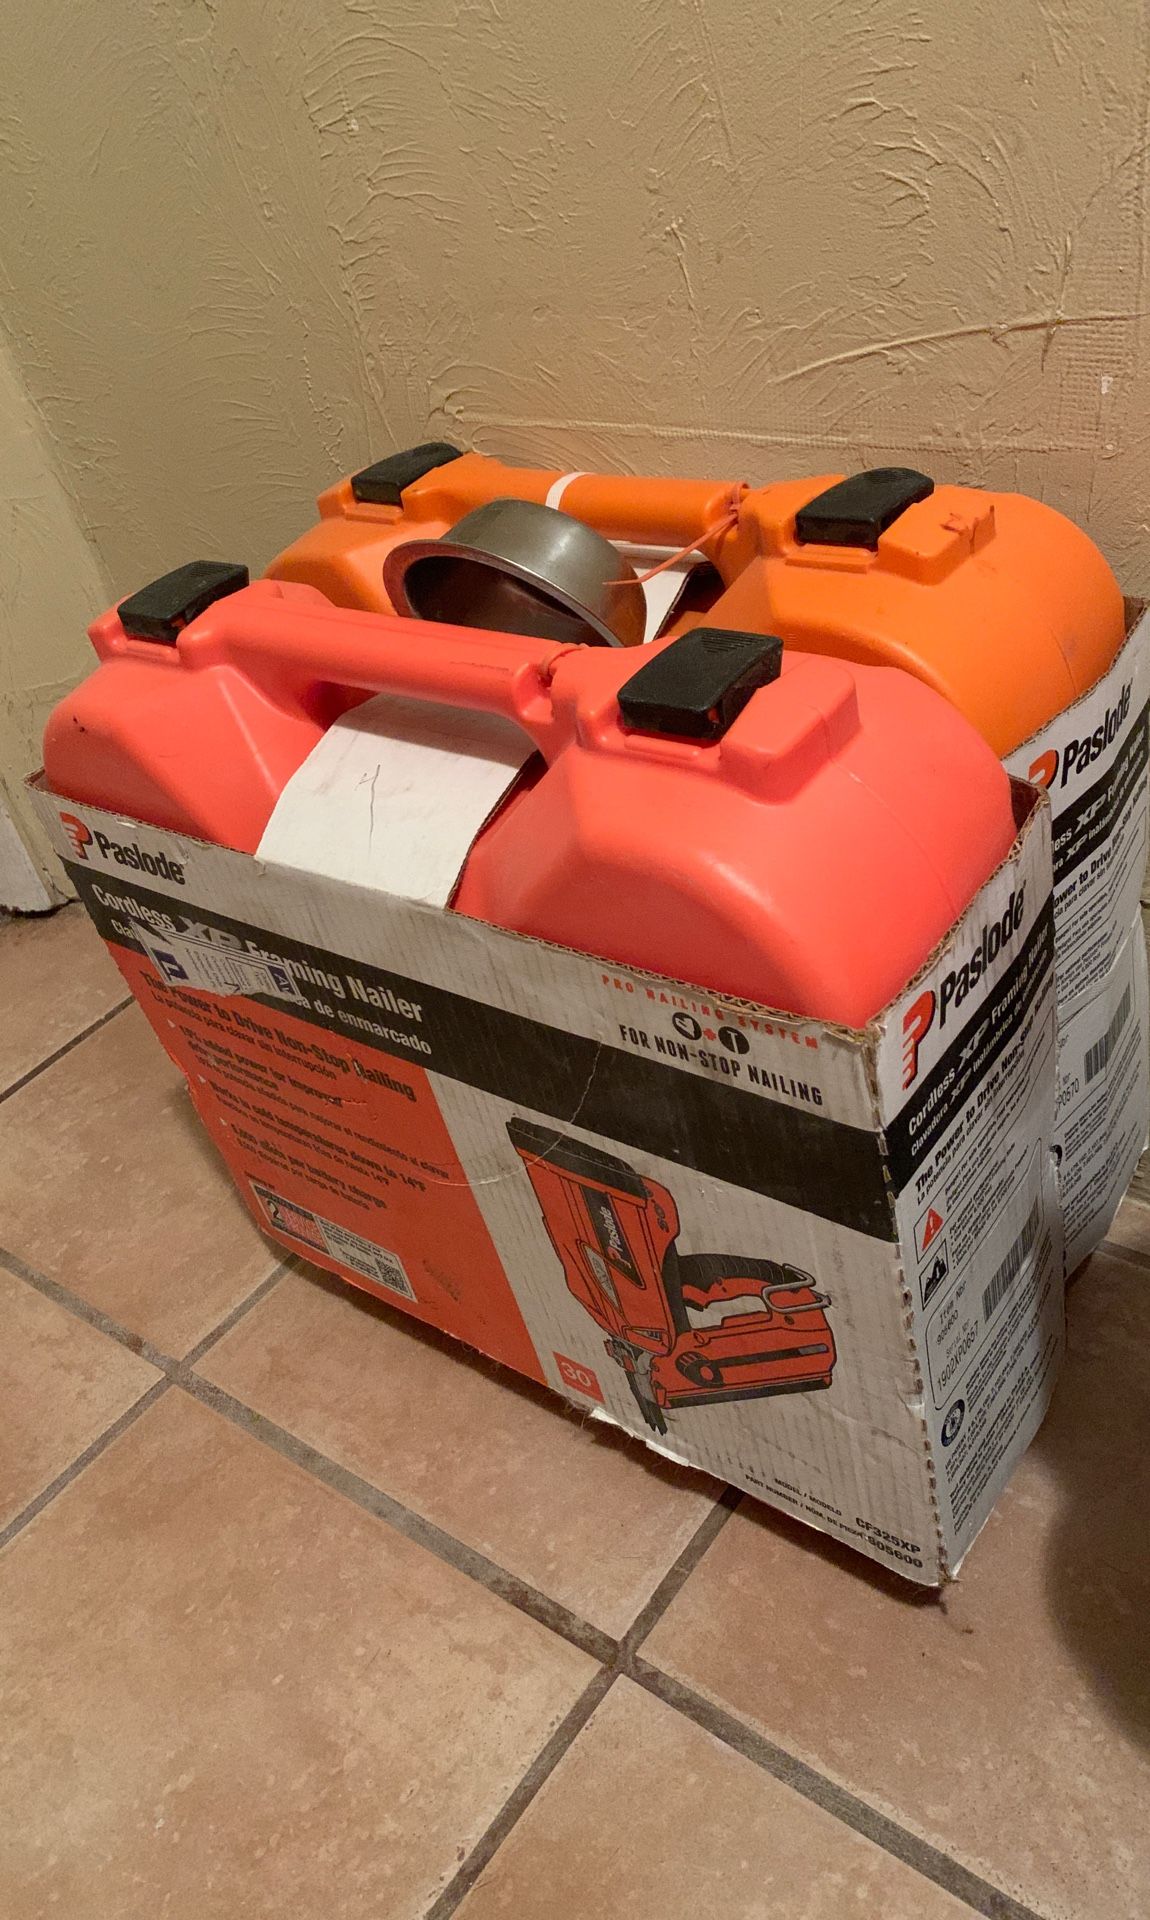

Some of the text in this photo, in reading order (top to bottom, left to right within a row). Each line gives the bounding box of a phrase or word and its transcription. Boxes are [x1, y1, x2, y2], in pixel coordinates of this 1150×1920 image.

[1061, 682, 1131, 788] Paslode
[1074, 793, 1107, 835] XP
[93, 830, 185, 885] Paslode
[1053, 880, 1077, 908] ower
[1079, 870, 1088, 885] to
[91, 884, 177, 932] Cordless
[346, 974, 423, 1022] Nailer
[939, 886, 1026, 1029] Paslode
[314, 999, 335, 1019] de
[337, 1009, 432, 1055] enmarcado
[602, 974, 819, 1050] PRO NAILING SYSTEM
[618, 1024, 823, 1106] FOR NON-STOP NAILING
[908, 1067, 955, 1136] Cordless
[957, 1017, 990, 1073] XP
[992, 966, 1028, 1025] Framing
[911, 1102, 948, 1157] Clavadora
[914, 1163, 933, 1194] The
[934, 1120, 964, 1166] Power
[965, 1104, 976, 1122] to
[976, 1071, 1000, 1108] Drive
[917, 1190, 925, 1206] La
[925, 1156, 952, 1196] potencia
[951, 1135, 966, 1159] para
[855, 1516, 922, 1554] CF325XP
